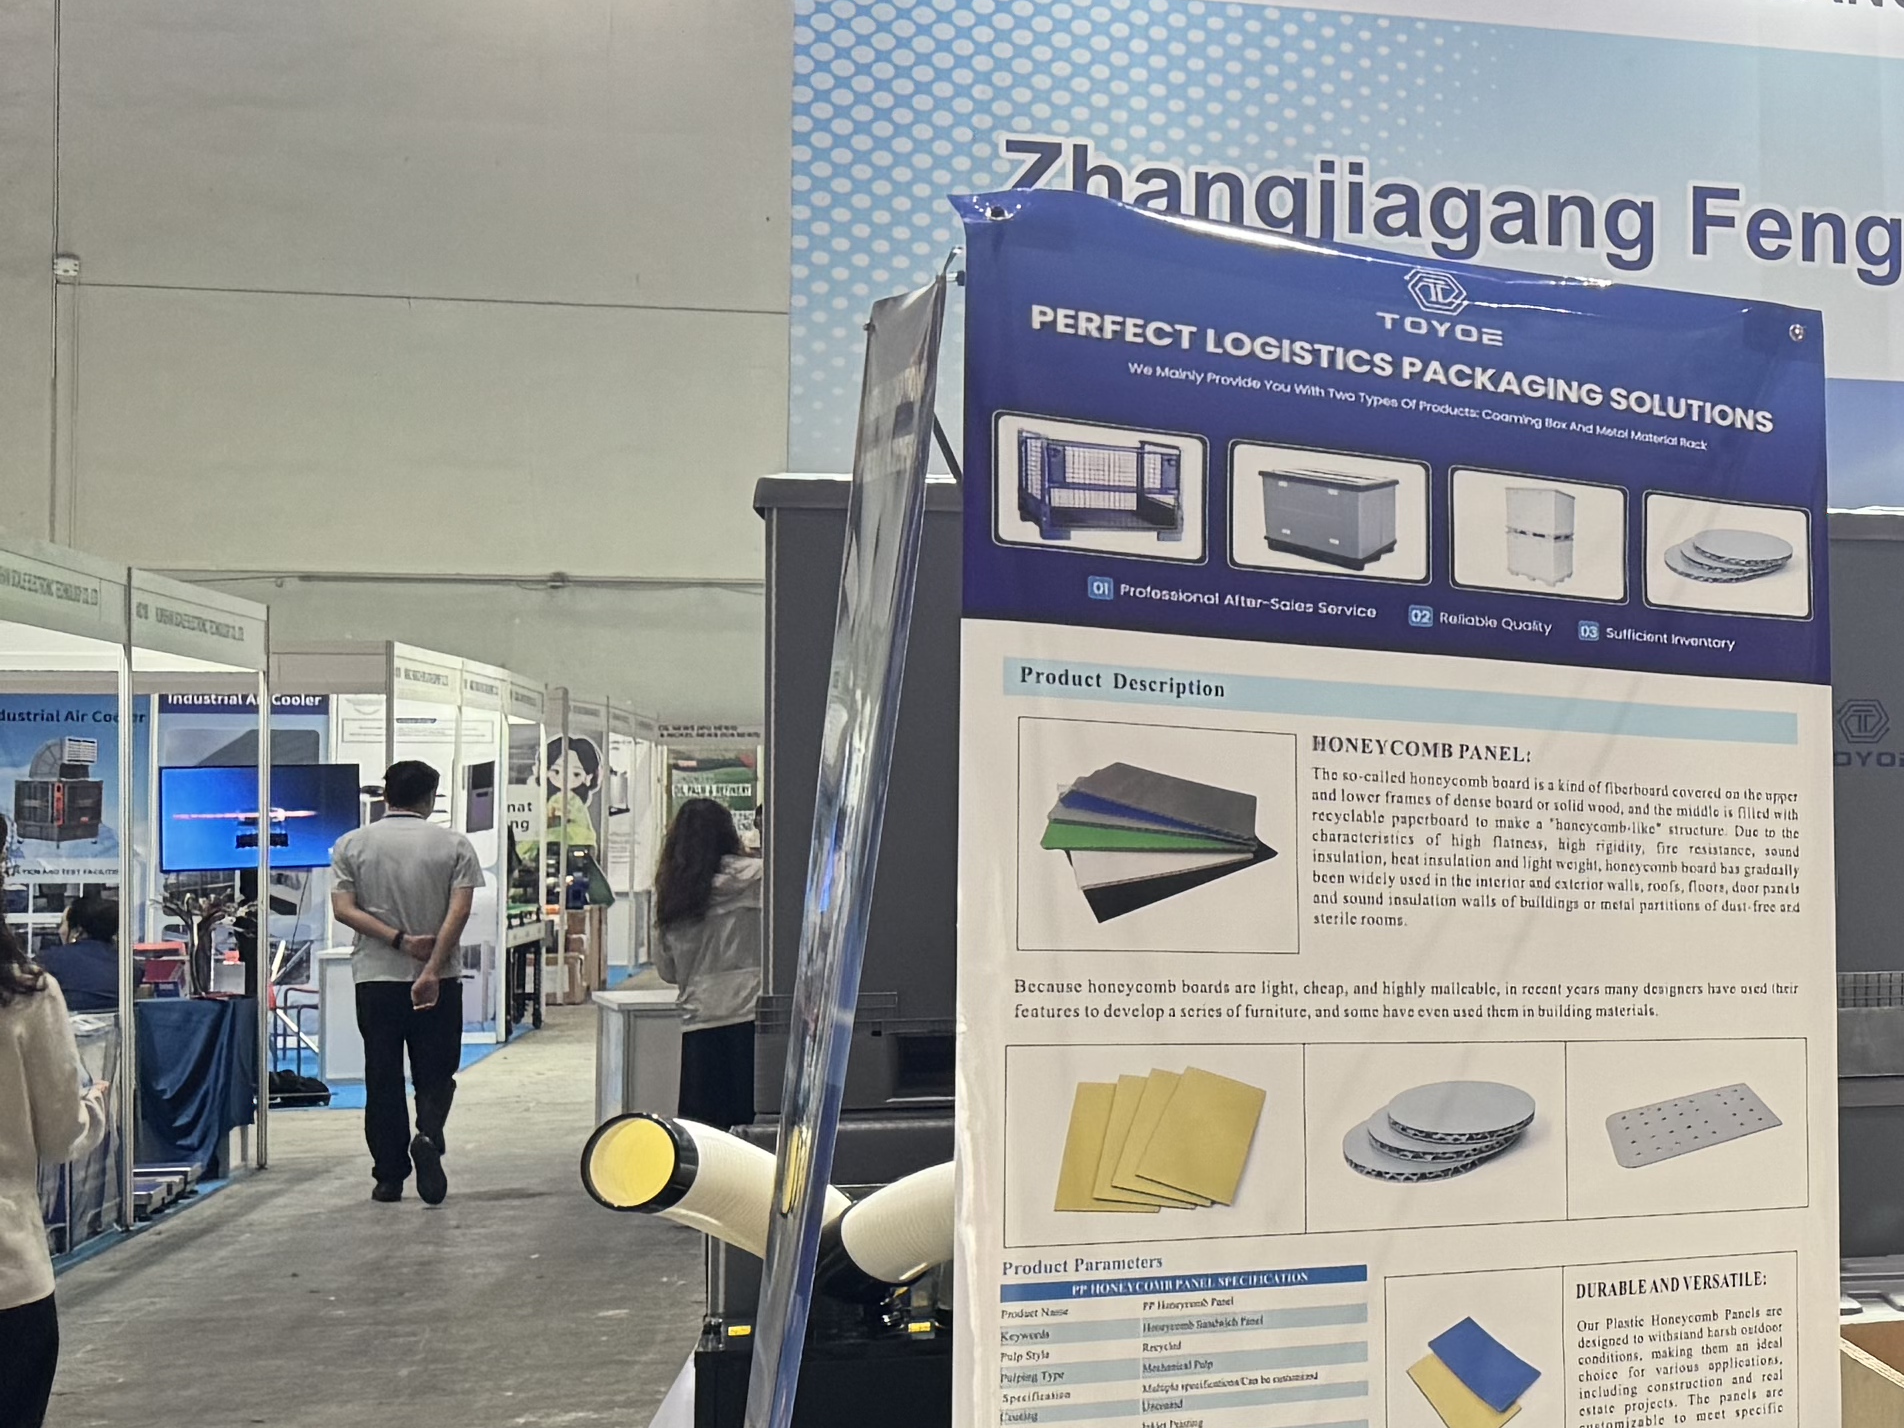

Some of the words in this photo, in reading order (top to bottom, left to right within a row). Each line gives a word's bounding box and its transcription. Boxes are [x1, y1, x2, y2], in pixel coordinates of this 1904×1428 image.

[1003, 138, 1656, 271] Zhangjiagang
[1375, 310, 1504, 348] TOYOE
[1032, 304, 1197, 350] PERFECT
[1206, 328, 1393, 377] LOGISTICS
[1402, 356, 1603, 406] PACKAGING
[1610, 387, 1773, 433] SOLUTIONS
[1121, 583, 1219, 605] Professional
[1224, 593, 1313, 613] After-Sales
[1318, 602, 1376, 618] Service
[1410, 608, 1431, 625] 02
[1440, 611, 1497, 628] Reliable
[1501, 617, 1552, 636] Quality
[1606, 627, 1667, 645] Sufficient
[1672, 633, 1735, 653] Inventory
[1021, 666, 1101, 688] Product
[1114, 673, 1224, 699] Description
[271, 694, 322, 708] Cooler
[0, 709, 61, 723] dustrial
[64, 709, 88, 723] Air
[1313, 735, 1453, 759] HONEYCOMB
[1459, 743, 1530, 763] PANEL:
[1003, 1259, 1068, 1276] Product
[1075, 1256, 1164, 1272] Parameters
[1071, 1284, 1089, 1297] PP
[1176, 1277, 1215, 1291] PANEL
[1577, 1279, 1646, 1299] DURABLE
[1650, 1277, 1679, 1293] AND
[1683, 1270, 1766, 1291] VERSATILE:
